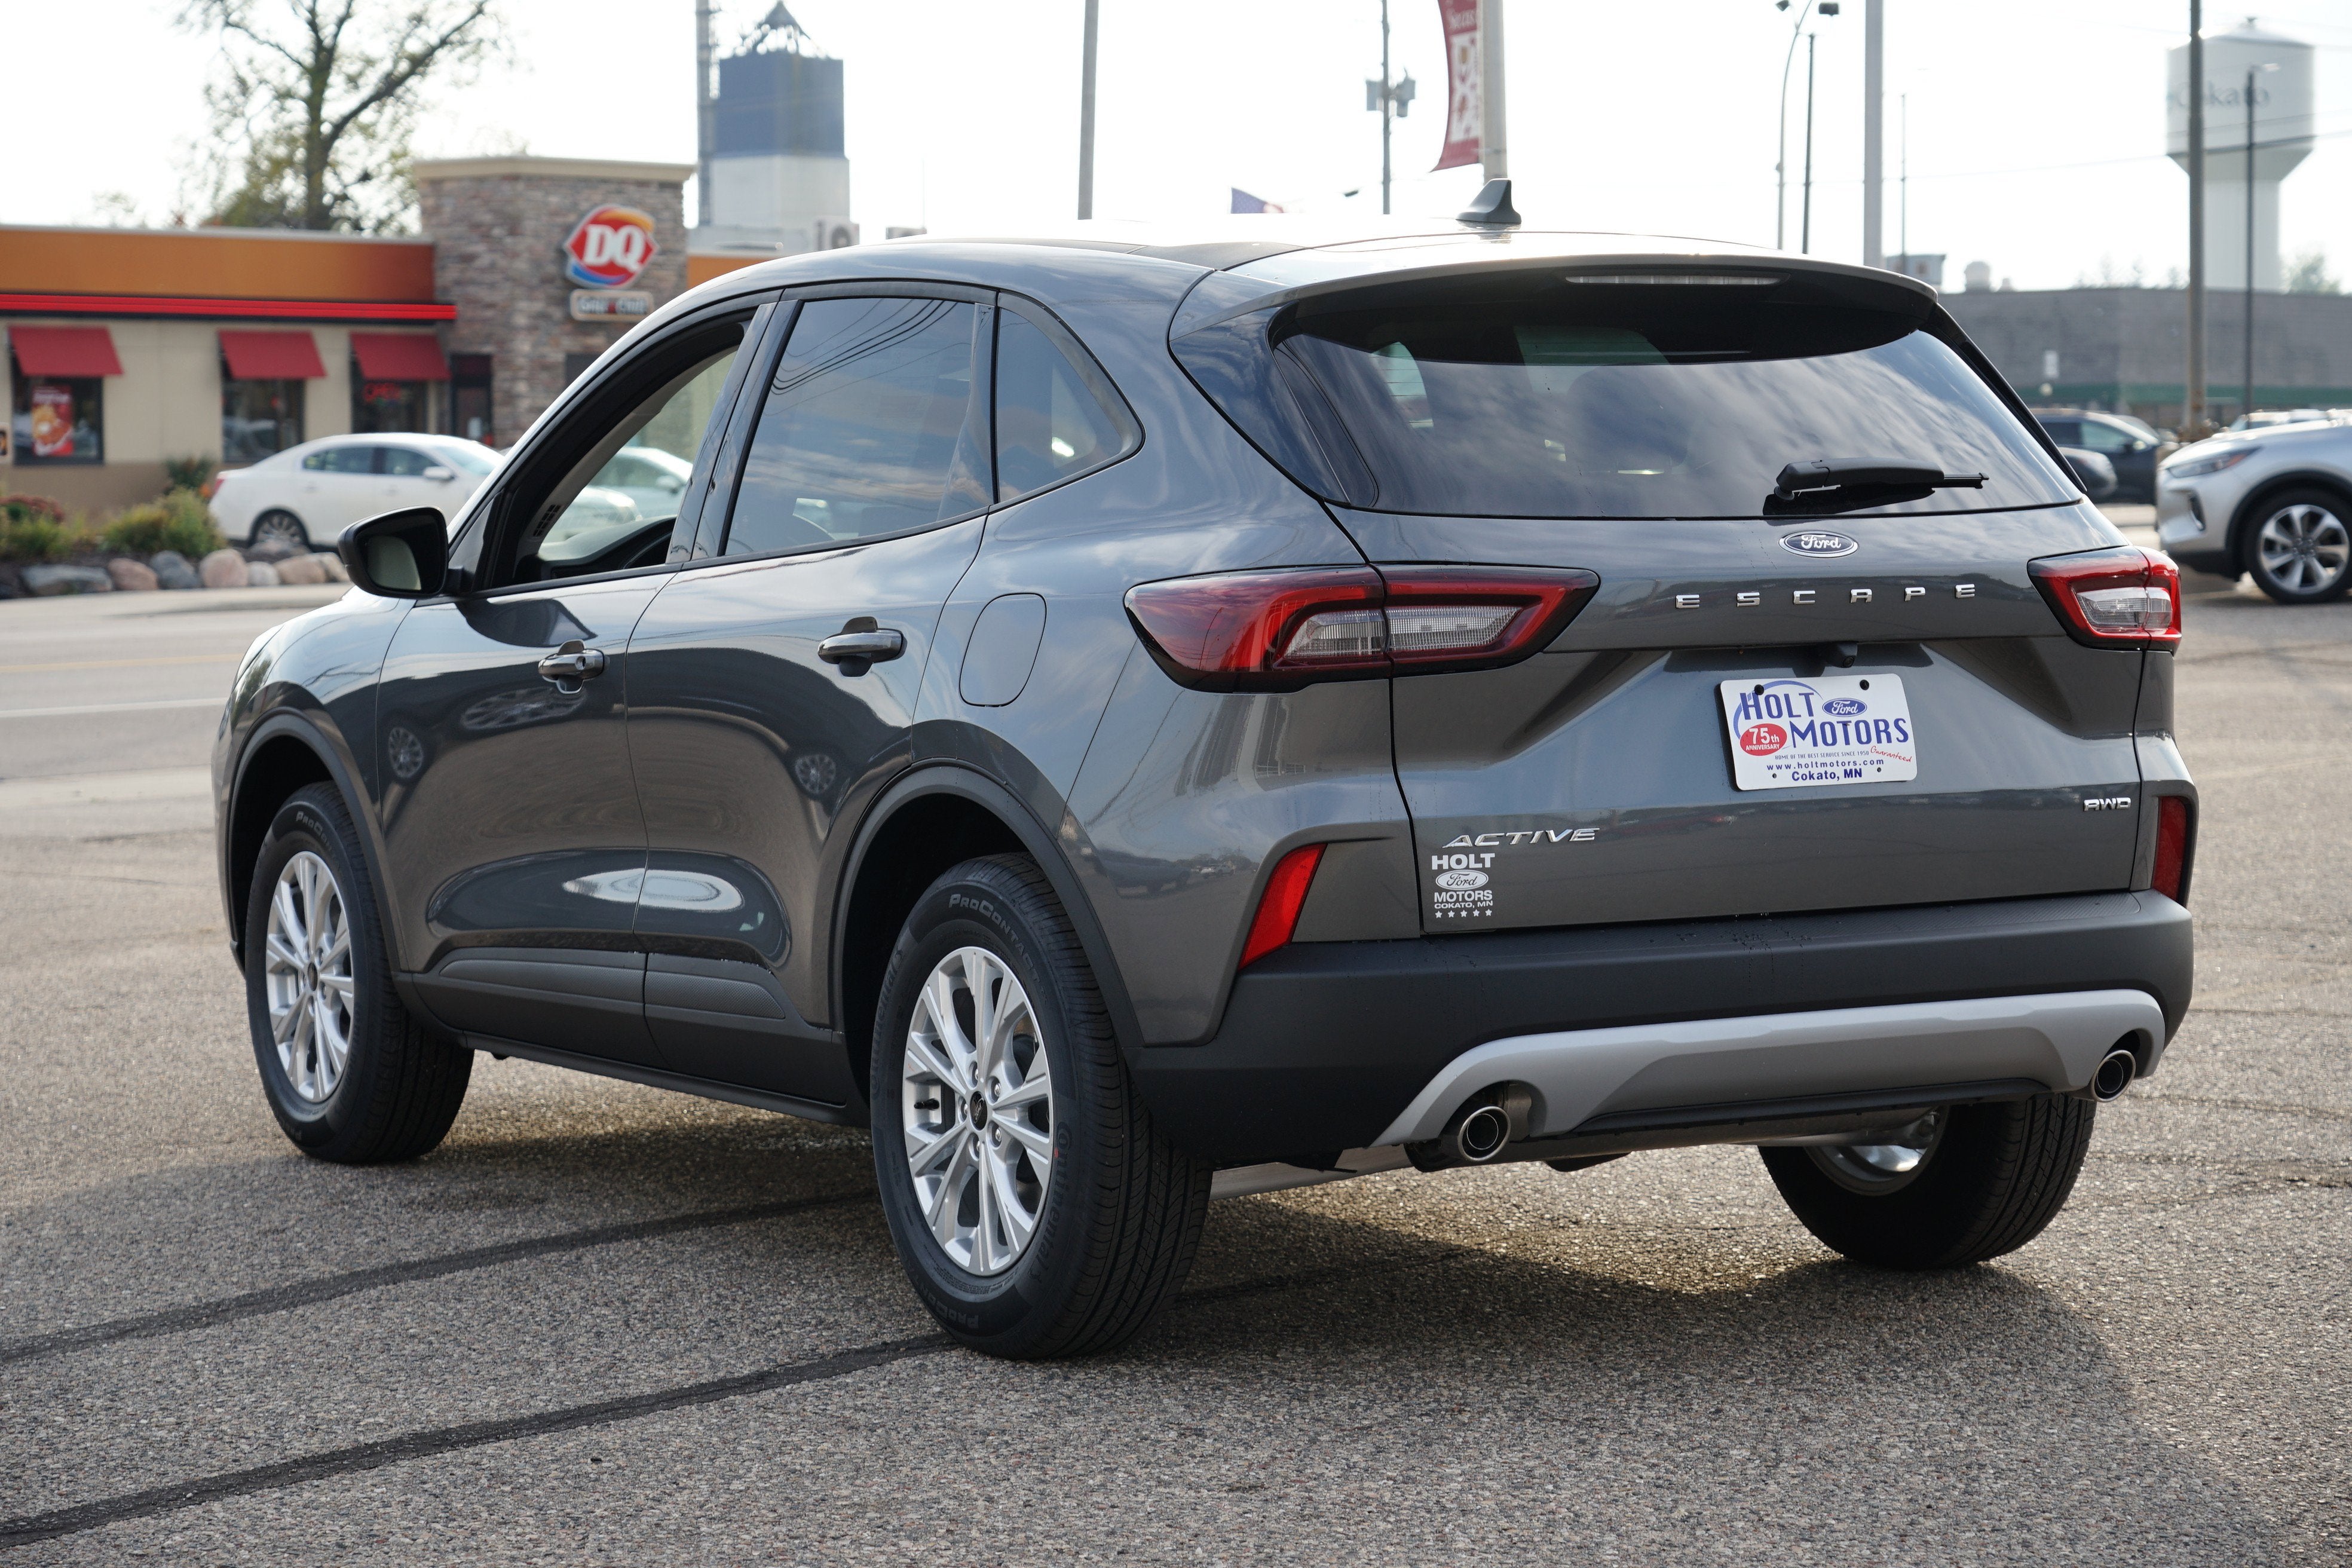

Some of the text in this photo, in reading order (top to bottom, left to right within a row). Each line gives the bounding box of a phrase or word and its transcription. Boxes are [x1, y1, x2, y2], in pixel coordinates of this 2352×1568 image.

[583, 223, 645, 273] DQ
[1676, 583, 1976, 610] ESCAPE
[1740, 693, 1815, 720] HOLT
[1749, 727, 1780, 745] 75th
[1789, 718, 1909, 748] MOTORS
[1870, 745, 1912, 762] Guaranteed
[1766, 759, 1884, 770] www.holtmotors.com
[1792, 768, 1863, 781] Cokato, MN
[2084, 797, 2131, 811] AWD
[1441, 828, 1600, 848] ACTIVE
[1432, 853, 1495, 870] HOLT
[1447, 873, 1477, 886] Ford
[1434, 890, 1493, 903] MOTORS
[1037, 1120, 1073, 1272] Continental
